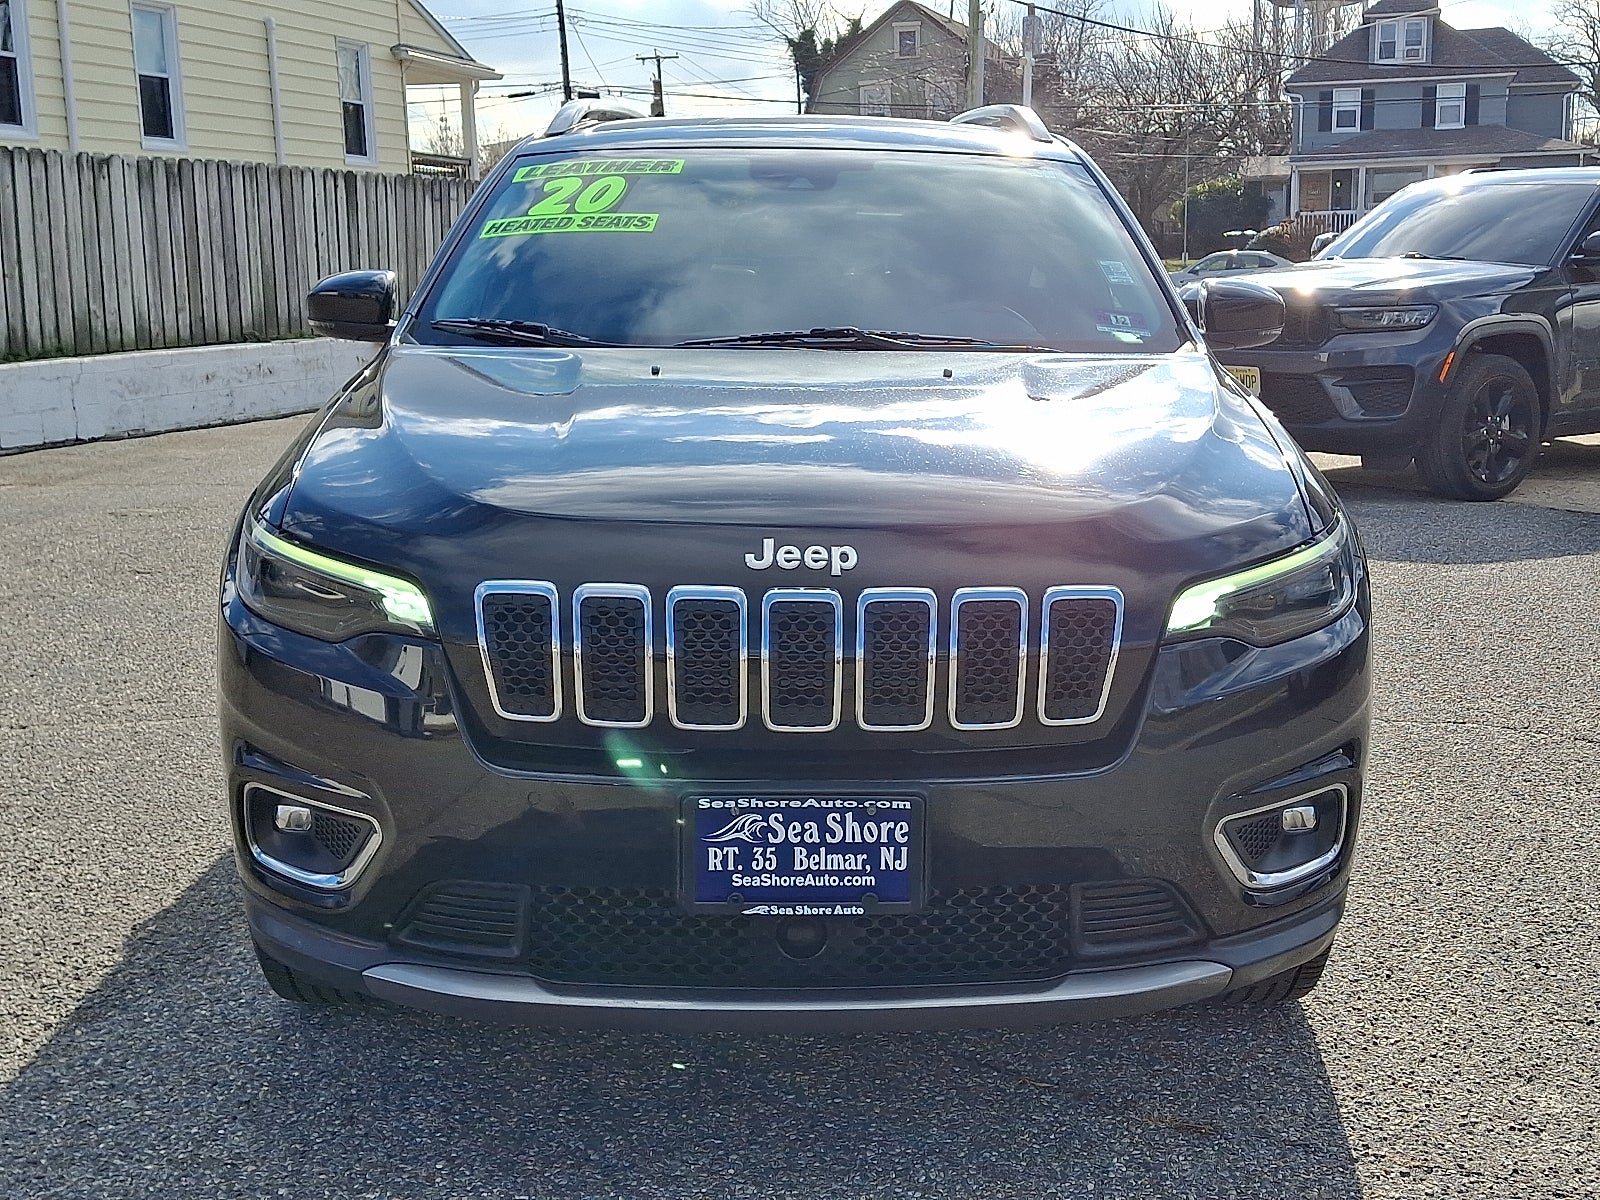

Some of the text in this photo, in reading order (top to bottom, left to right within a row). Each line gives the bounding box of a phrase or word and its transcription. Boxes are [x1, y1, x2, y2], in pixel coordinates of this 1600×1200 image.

[520, 159, 678, 180] LEATHER
[528, 175, 627, 216] 20
[484, 215, 654, 236] HEATED SEATS
[744, 538, 858, 576] Jeep
[698, 797, 912, 810] SeaShoreAuto.com
[767, 811, 910, 845] Sea Shore
[707, 846, 909, 874] RT. 35 Belmar, NJ
[731, 873, 876, 887] SeaShoreAuto.com
[769, 904, 865, 915] Sea Shore Auto
